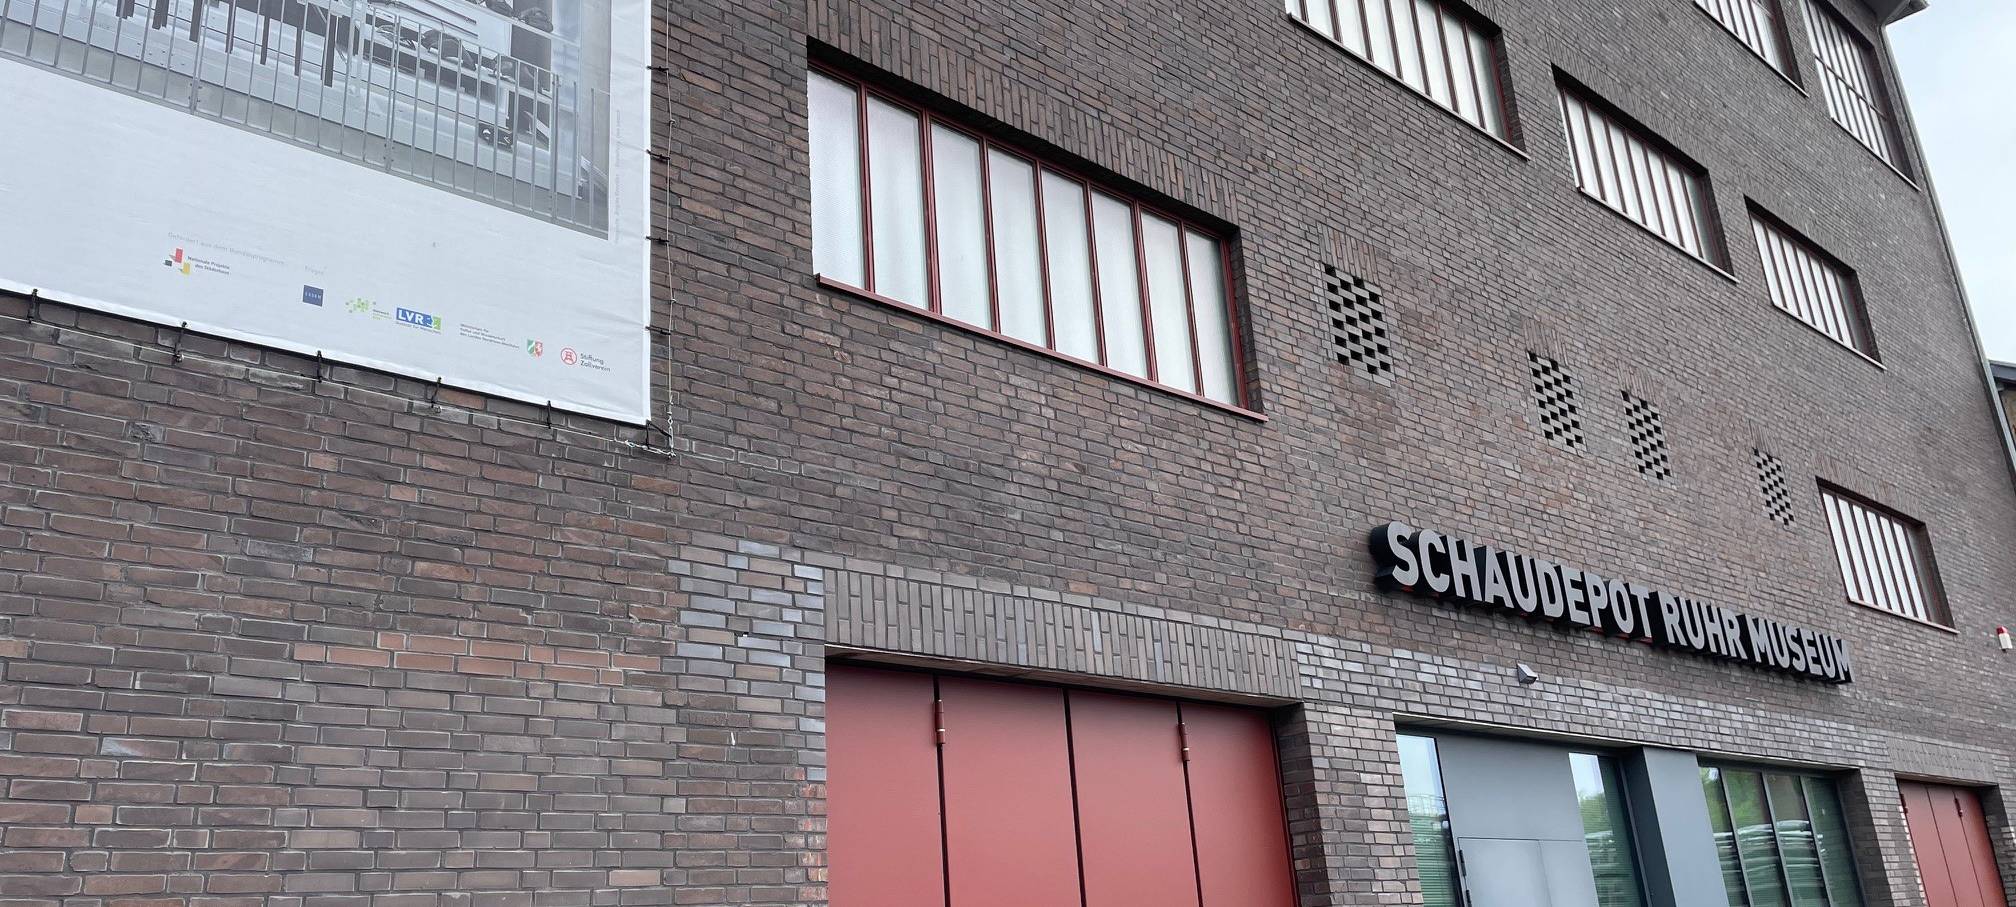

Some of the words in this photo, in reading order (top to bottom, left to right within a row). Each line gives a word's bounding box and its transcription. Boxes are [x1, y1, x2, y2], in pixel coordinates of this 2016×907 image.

[399, 309, 424, 325] LVR
[580, 353, 604, 366] Stiftung
[580, 359, 611, 372] Zollverein
[1387, 520, 1653, 638] SCHAUDEPOT
[1656, 590, 1748, 660] RUHR
[1745, 613, 1854, 683] MUSEUM
